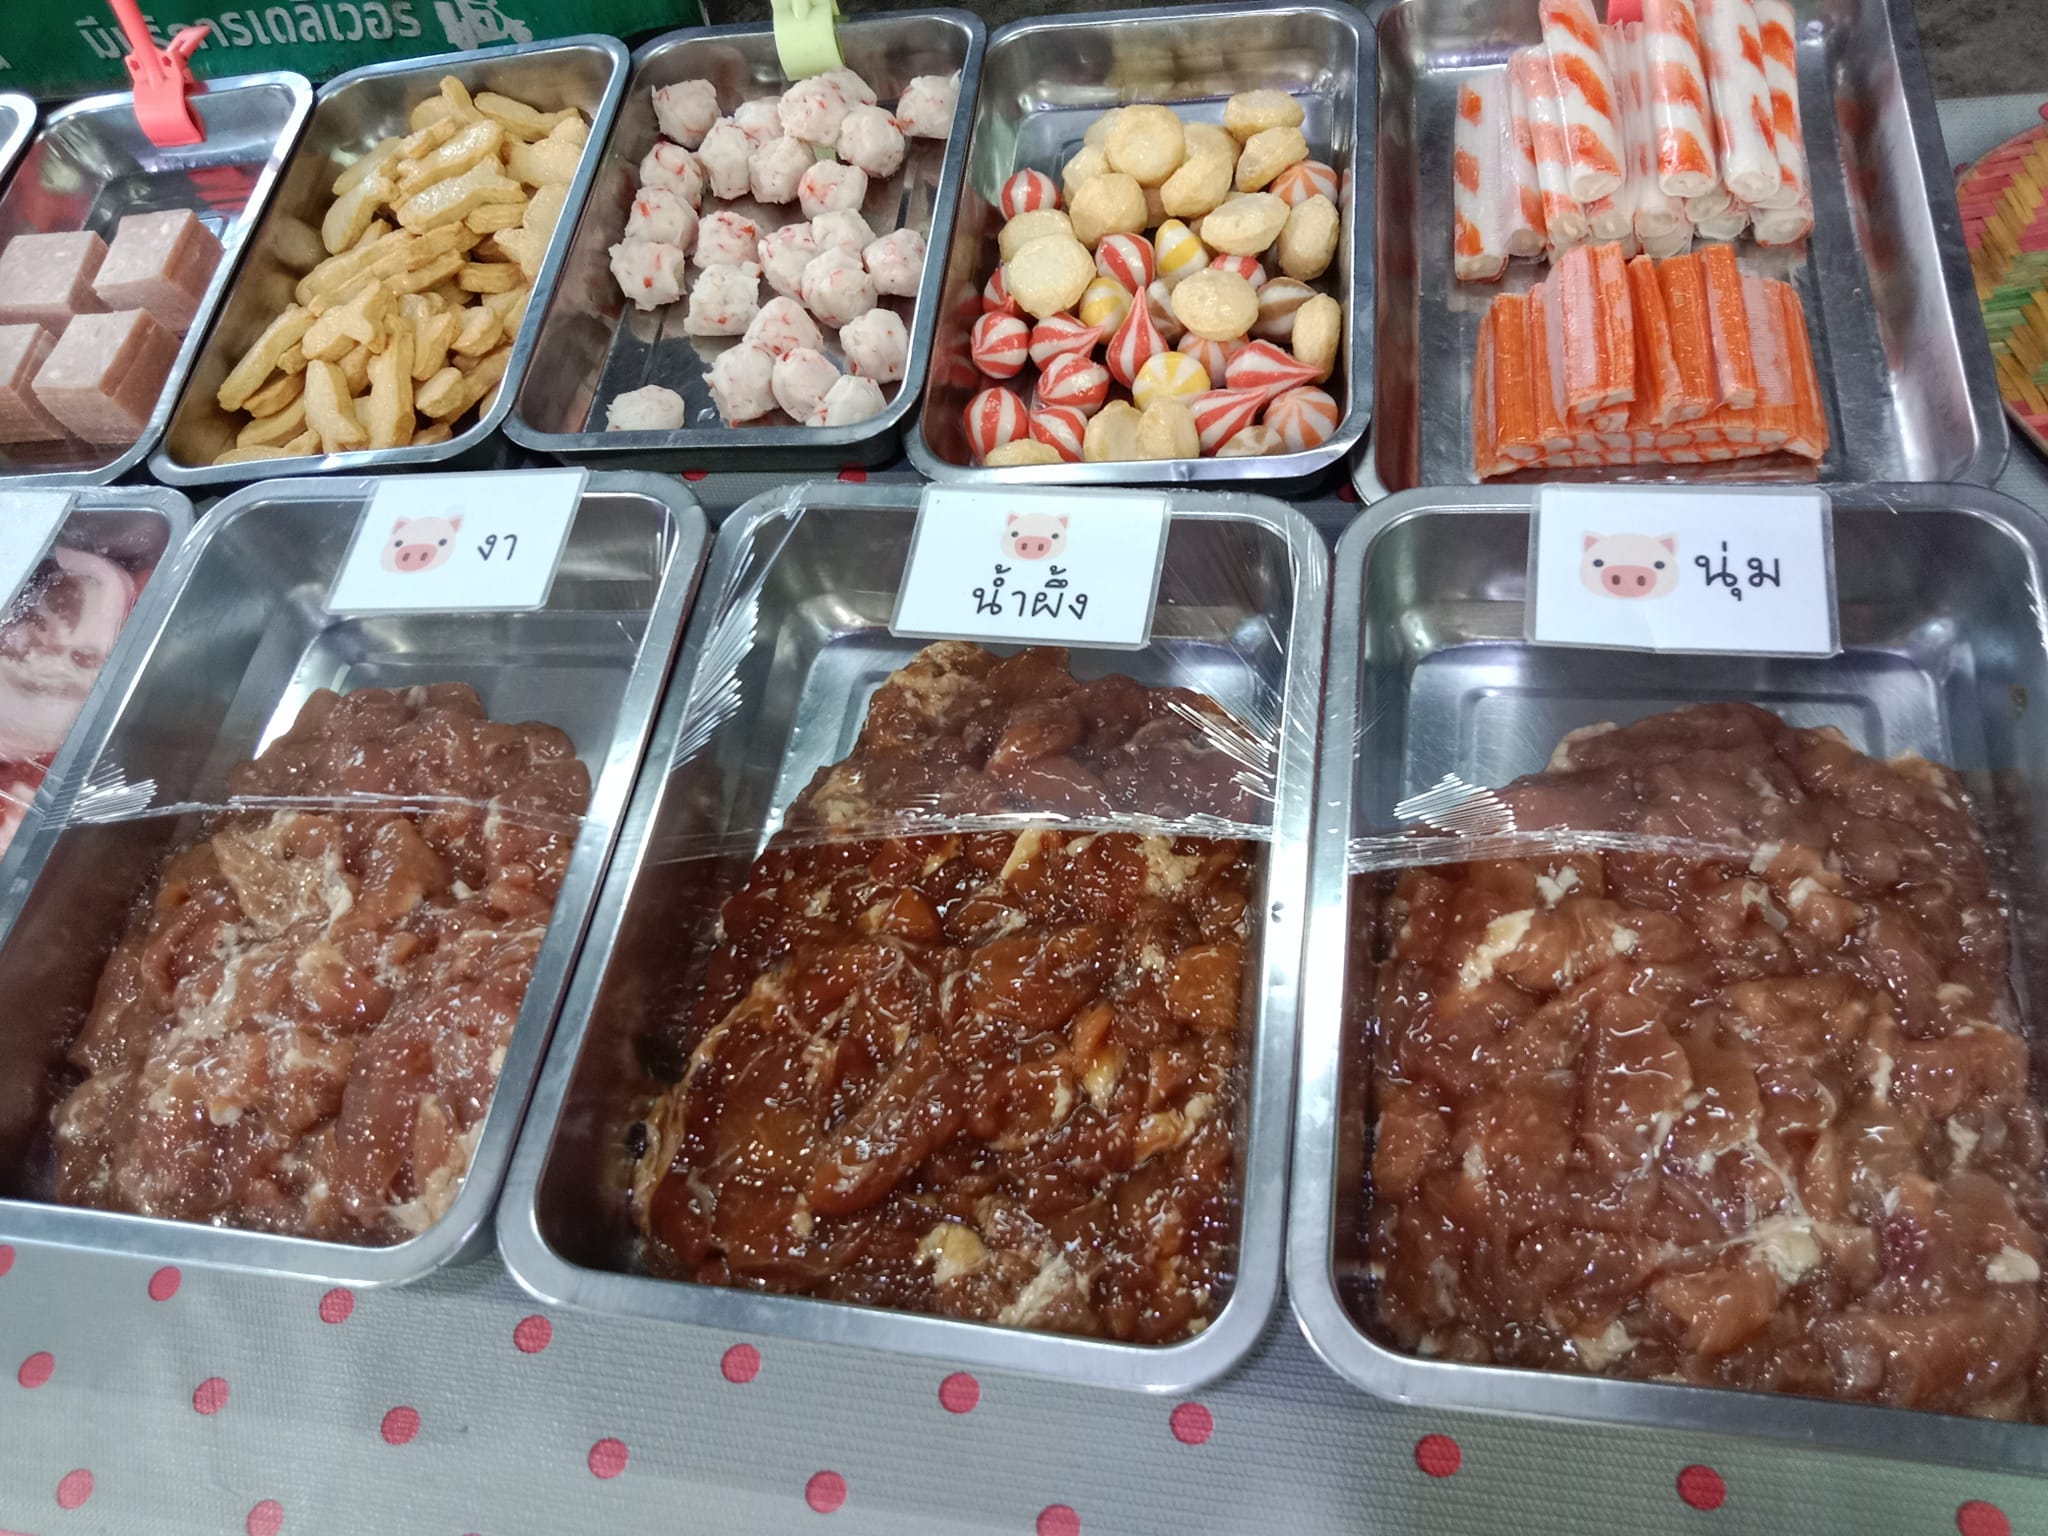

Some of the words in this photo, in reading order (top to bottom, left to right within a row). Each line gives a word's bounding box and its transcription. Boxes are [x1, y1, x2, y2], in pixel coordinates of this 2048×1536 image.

[477, 533, 518, 561] งา
[1694, 540, 1781, 602] นุ่ม
[972, 563, 1089, 621] น้ำผึ้ง
